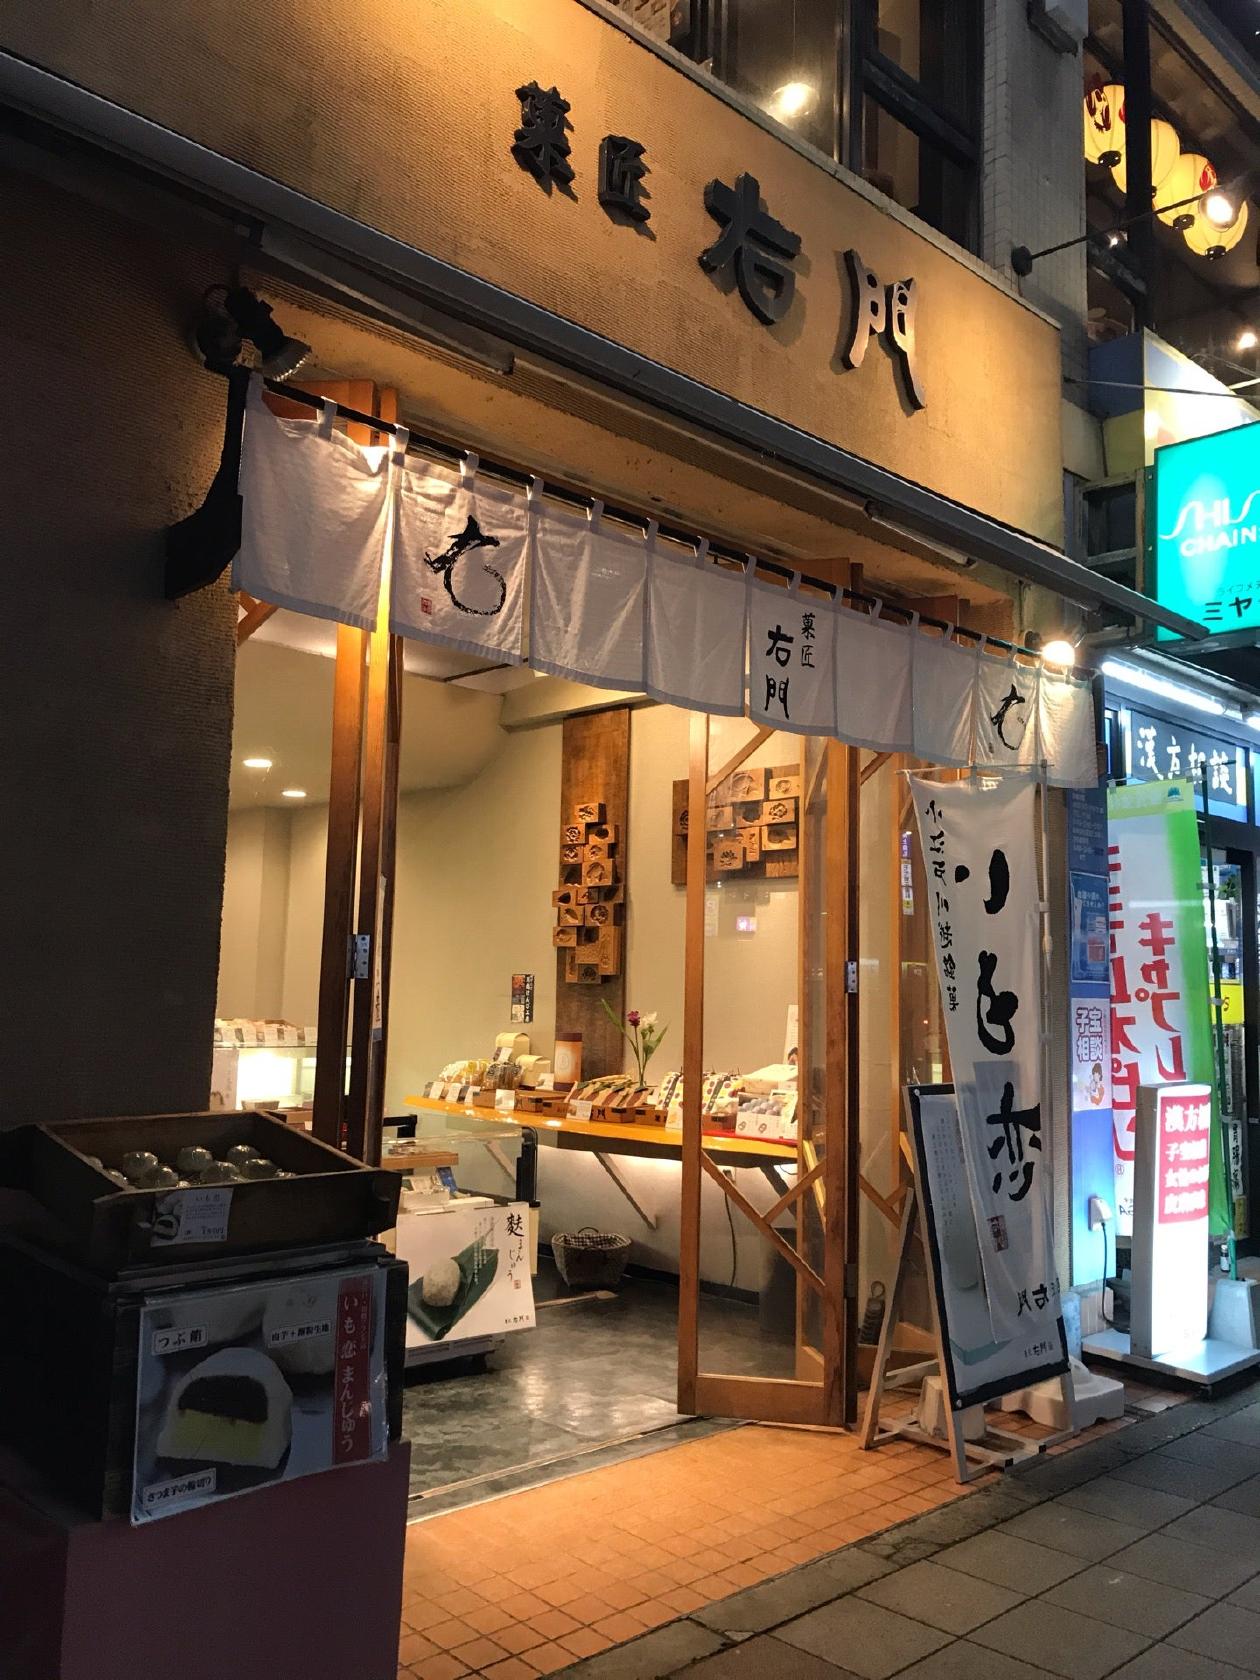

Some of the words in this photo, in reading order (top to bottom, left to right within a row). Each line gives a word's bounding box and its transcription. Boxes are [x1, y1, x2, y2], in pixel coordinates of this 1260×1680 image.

[511, 81, 652, 222] 菓匠
[699, 172, 926, 409] 右門
[1180, 525, 1257, 557] CHAIN
[801, 612, 816, 668] 菓匠
[764, 624, 795, 720] 右門
[1076, 1006, 1103, 1034] 子宝
[1077, 1034, 1103, 1063] 相談
[339, 1295, 359, 1453] いも恋まんじゅう
